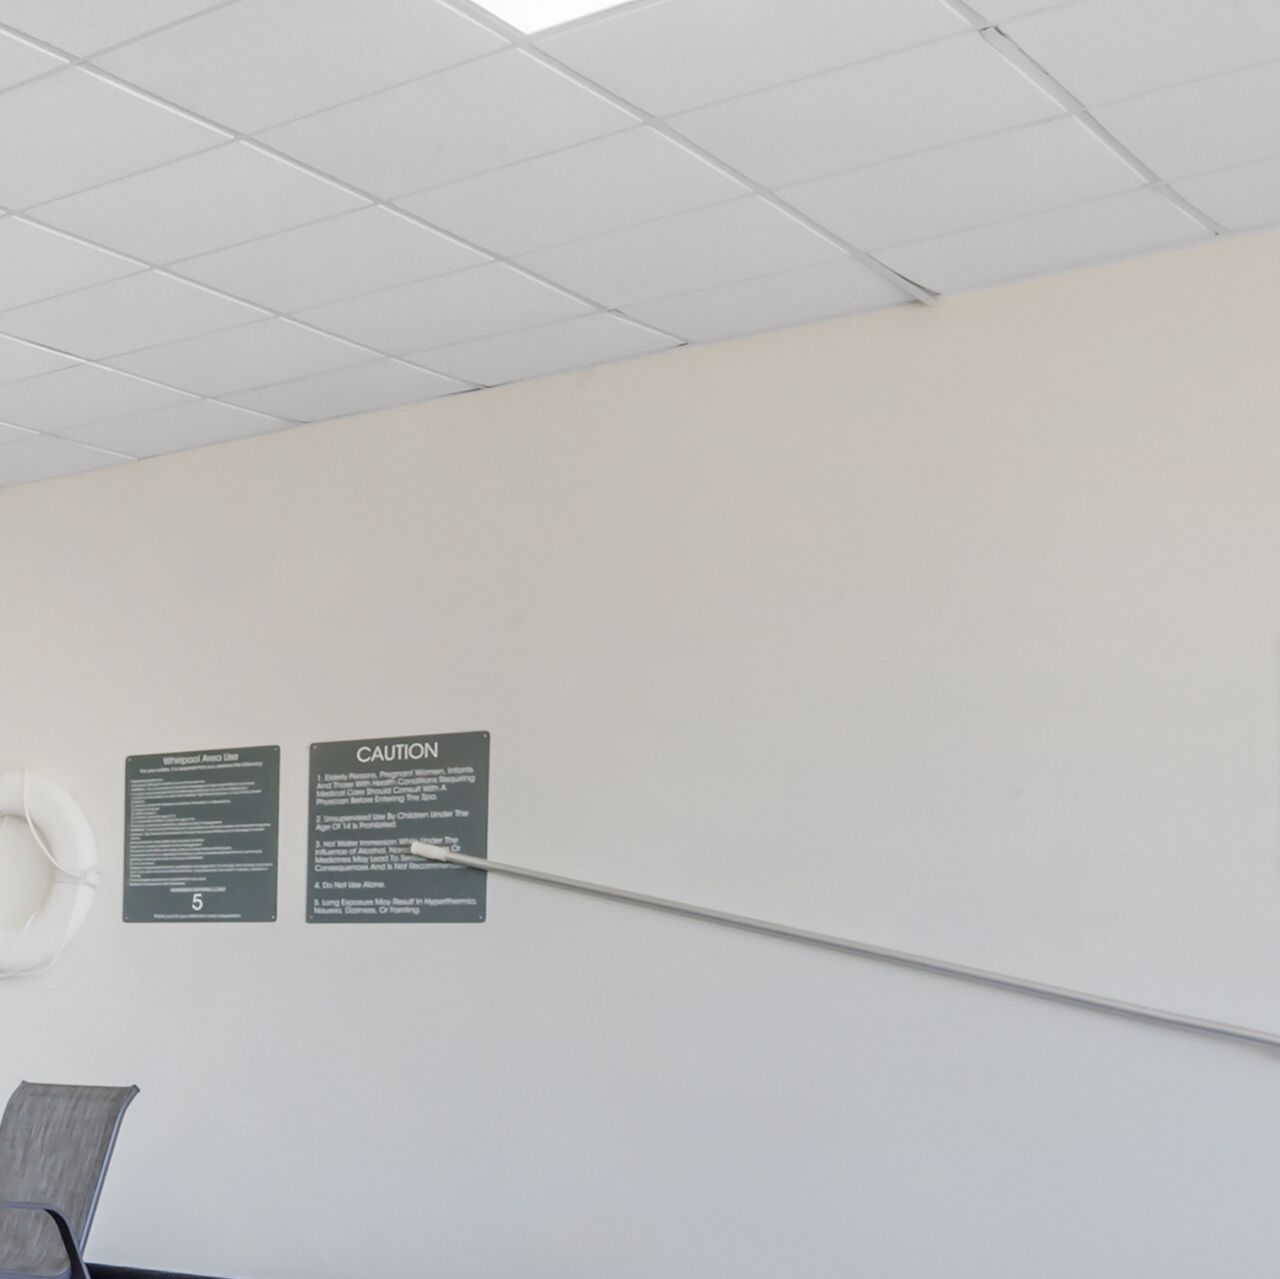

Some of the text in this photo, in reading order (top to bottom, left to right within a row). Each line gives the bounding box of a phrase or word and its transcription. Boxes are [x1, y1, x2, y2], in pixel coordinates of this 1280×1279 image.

[163, 752, 239, 766] Whirlpool Area Use
[356, 742, 439, 763] CAUTION
[325, 773, 348, 783] Elderly
[380, 770, 413, 779] Pregnant
[333, 781, 354, 789] Those
[355, 780, 371, 788] With
[372, 778, 396, 787] Health
[397, 777, 438, 786] Conditions
[439, 775, 476, 784] Requiring
[316, 783, 447, 798] Medical Care Should Consult With A
[316, 798, 349, 807] Physician
[350, 796, 374, 805] Before
[374, 794, 405, 804] Entering
[406, 793, 420, 802] The
[323, 813, 371, 824] Unsupervised
[372, 812, 386, 821] Use
[386, 811, 396, 822] By
[397, 811, 429, 820] Children
[430, 810, 453, 819] Under
[454, 808, 469, 818] The
[315, 823, 331, 833] Age
[331, 822, 341, 831] Of
[342, 822, 352, 831] 14
[352, 822, 358, 830] Is
[322, 840, 336, 848] Hot
[337, 839, 358, 848] Water
[359, 839, 398, 848] Immersion
[444, 835, 458, 844] The
[450, 843, 461, 853] Or
[314, 848, 348, 857] Influence
[314, 856, 352, 864] Medicines
[352, 855, 369, 865] May
[369, 854, 388, 863] Lead
[389, 854, 400, 862] To
[314, 864, 369, 873] Consequences
[369, 863, 387, 872] And
[387, 863, 393, 871] Is
[393, 862, 408, 871] Not
[321, 881, 334, 889] Do
[334, 880, 348, 889] Not
[348, 880, 362, 889] Use
[192, 893, 203, 911] 5
[321, 899, 340, 908] Long
[341, 898, 374, 907] Exposure
[374, 897, 391, 906] May
[392, 897, 415, 906] Result
[415, 897, 423, 905] In
[378, 905, 389, 914] Or
